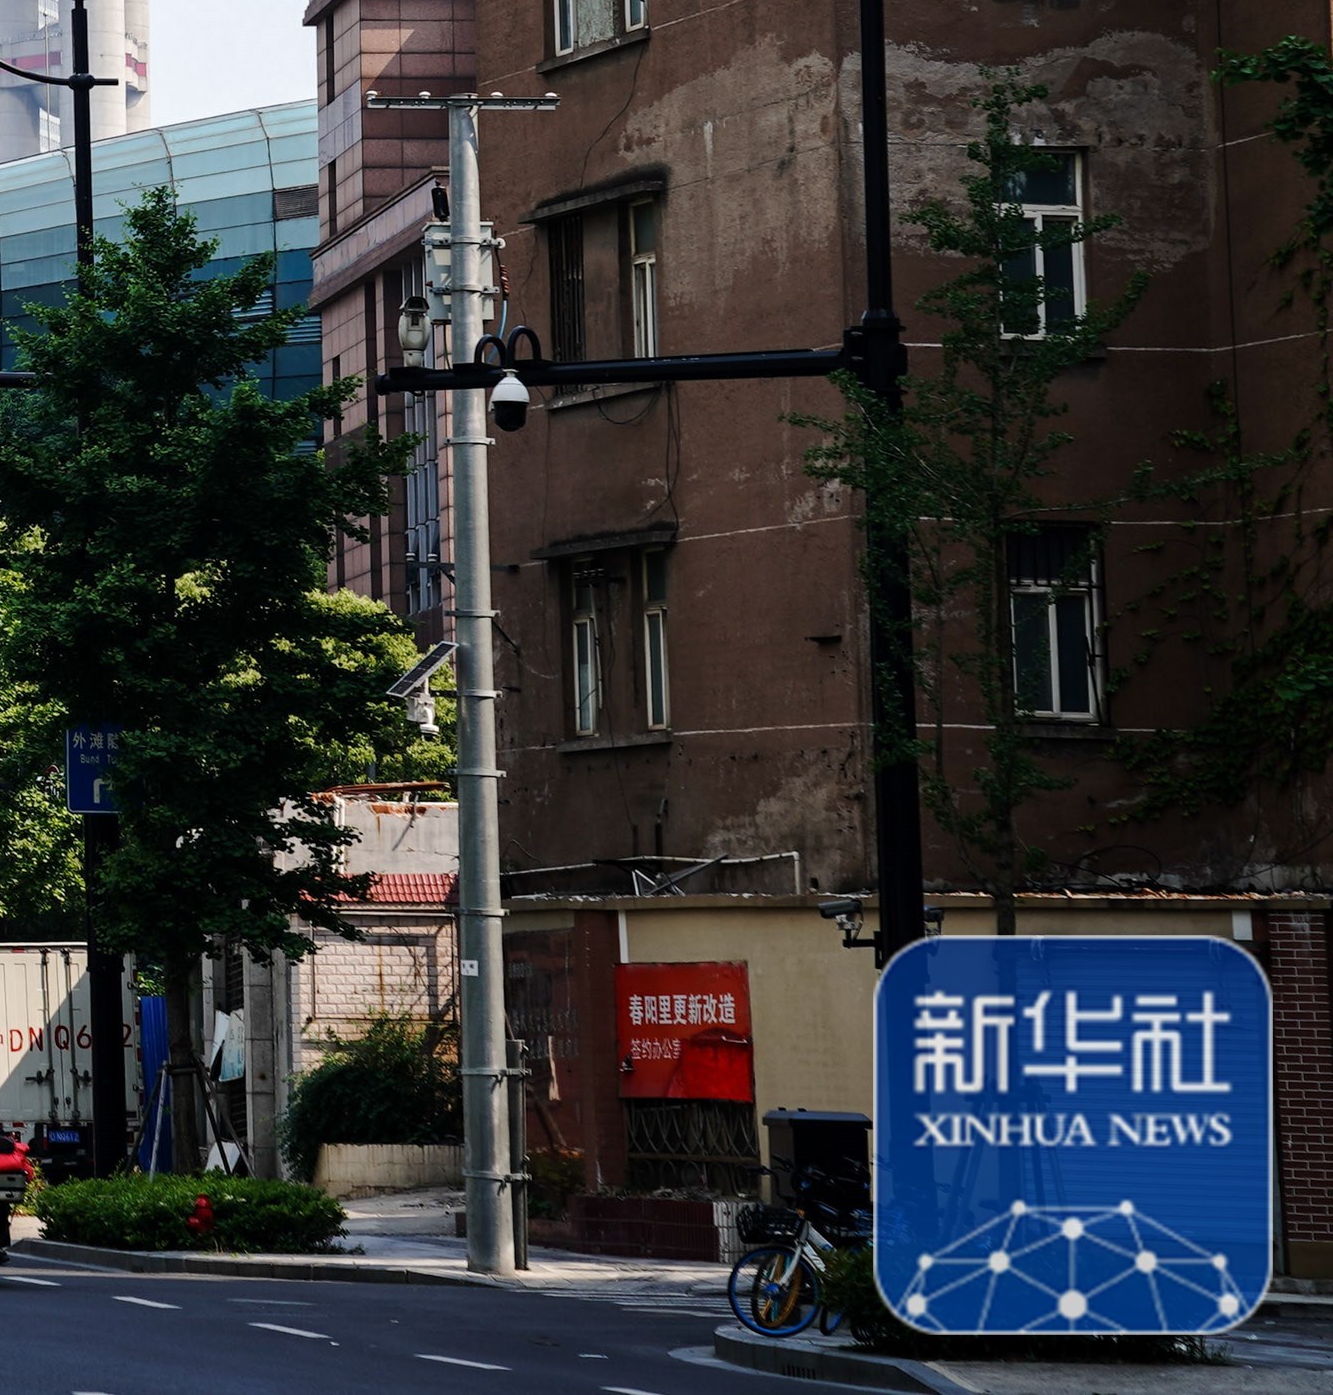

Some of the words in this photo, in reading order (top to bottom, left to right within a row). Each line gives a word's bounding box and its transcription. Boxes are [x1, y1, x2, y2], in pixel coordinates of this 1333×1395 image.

[80, 753, 100, 764] Bund
[629, 993, 736, 1025] 春阳里更新改造
